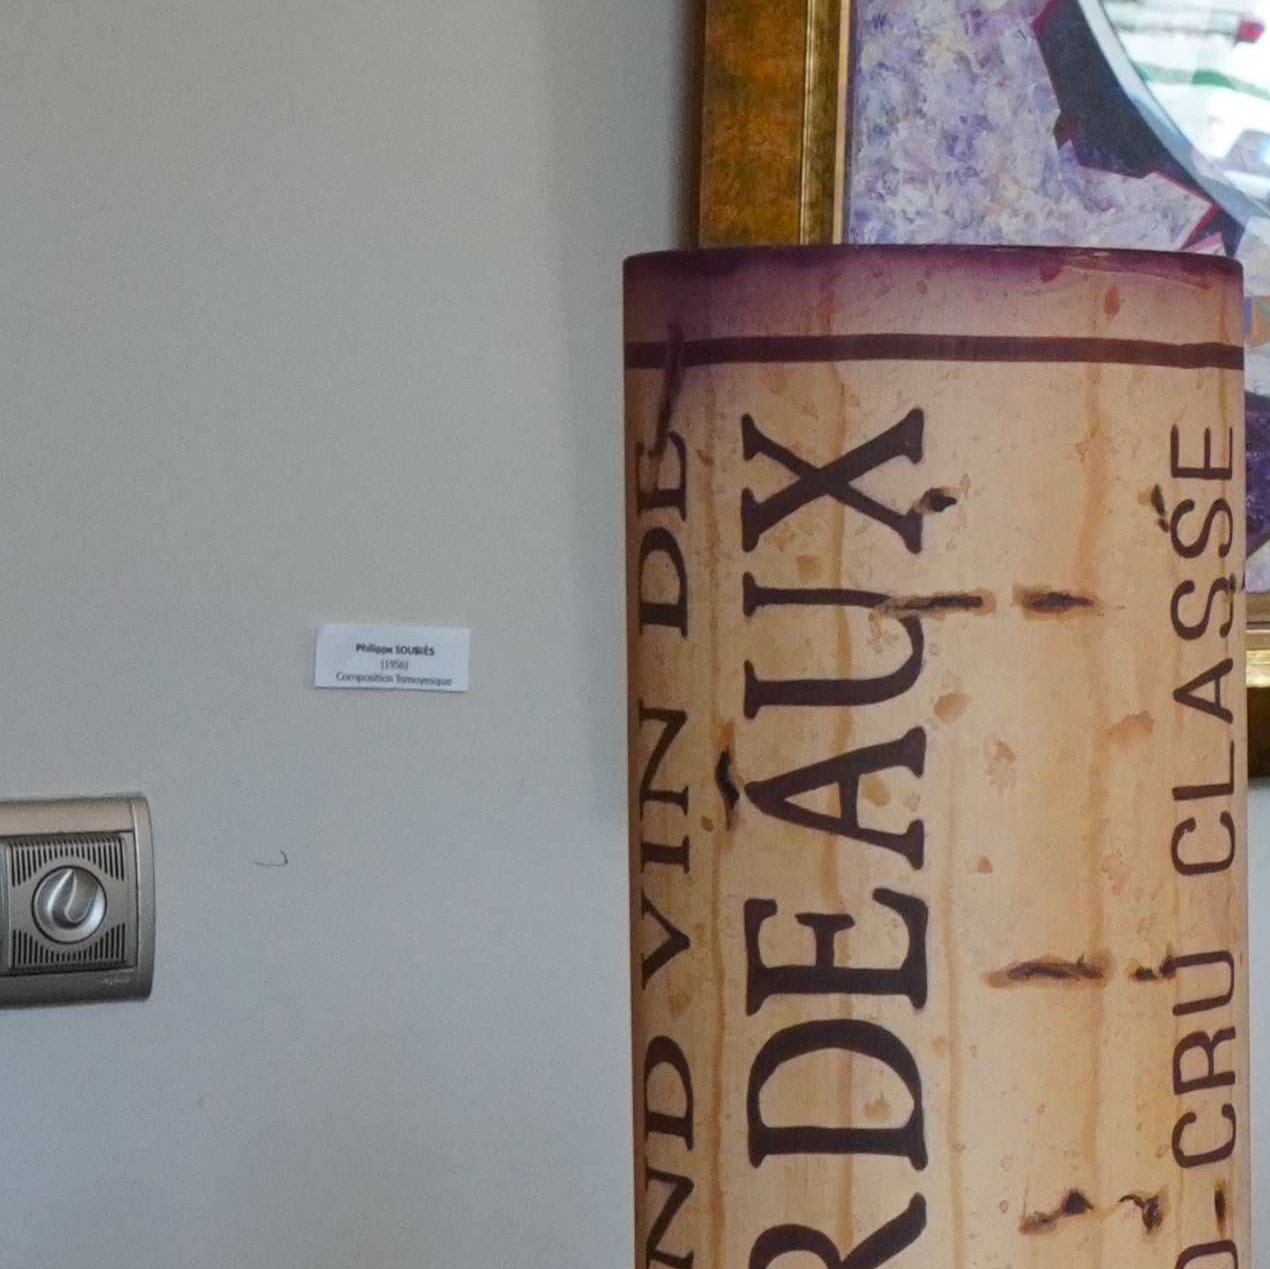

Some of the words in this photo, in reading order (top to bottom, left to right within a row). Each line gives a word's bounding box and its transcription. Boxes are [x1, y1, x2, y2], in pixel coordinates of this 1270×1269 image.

[633, 427, 689, 635] DE
[336, 671, 393, 683] Composition
[637, 697, 690, 989] VIN
[1169, 951, 1237, 1168] CRU
